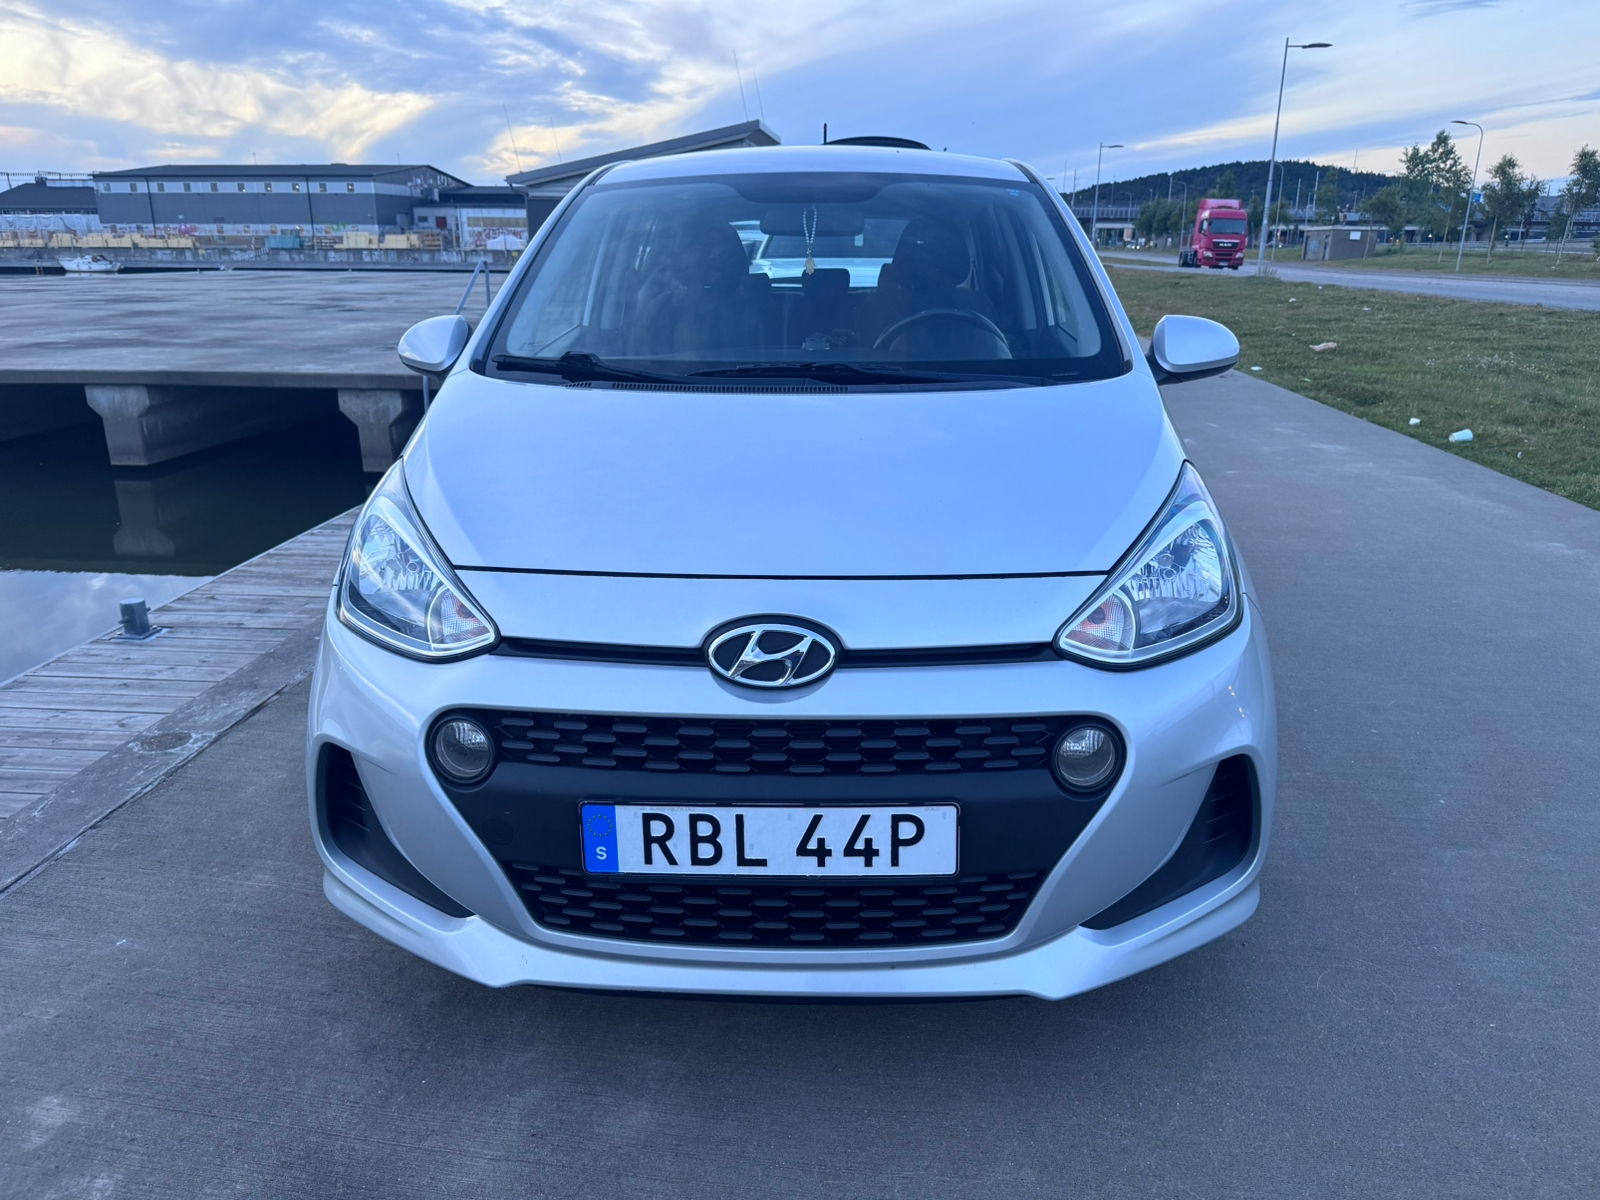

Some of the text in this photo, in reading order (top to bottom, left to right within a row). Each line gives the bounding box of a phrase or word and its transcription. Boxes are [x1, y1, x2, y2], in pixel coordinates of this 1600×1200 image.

[595, 846, 608, 861] S
[641, 812, 926, 868] RBL 44P
